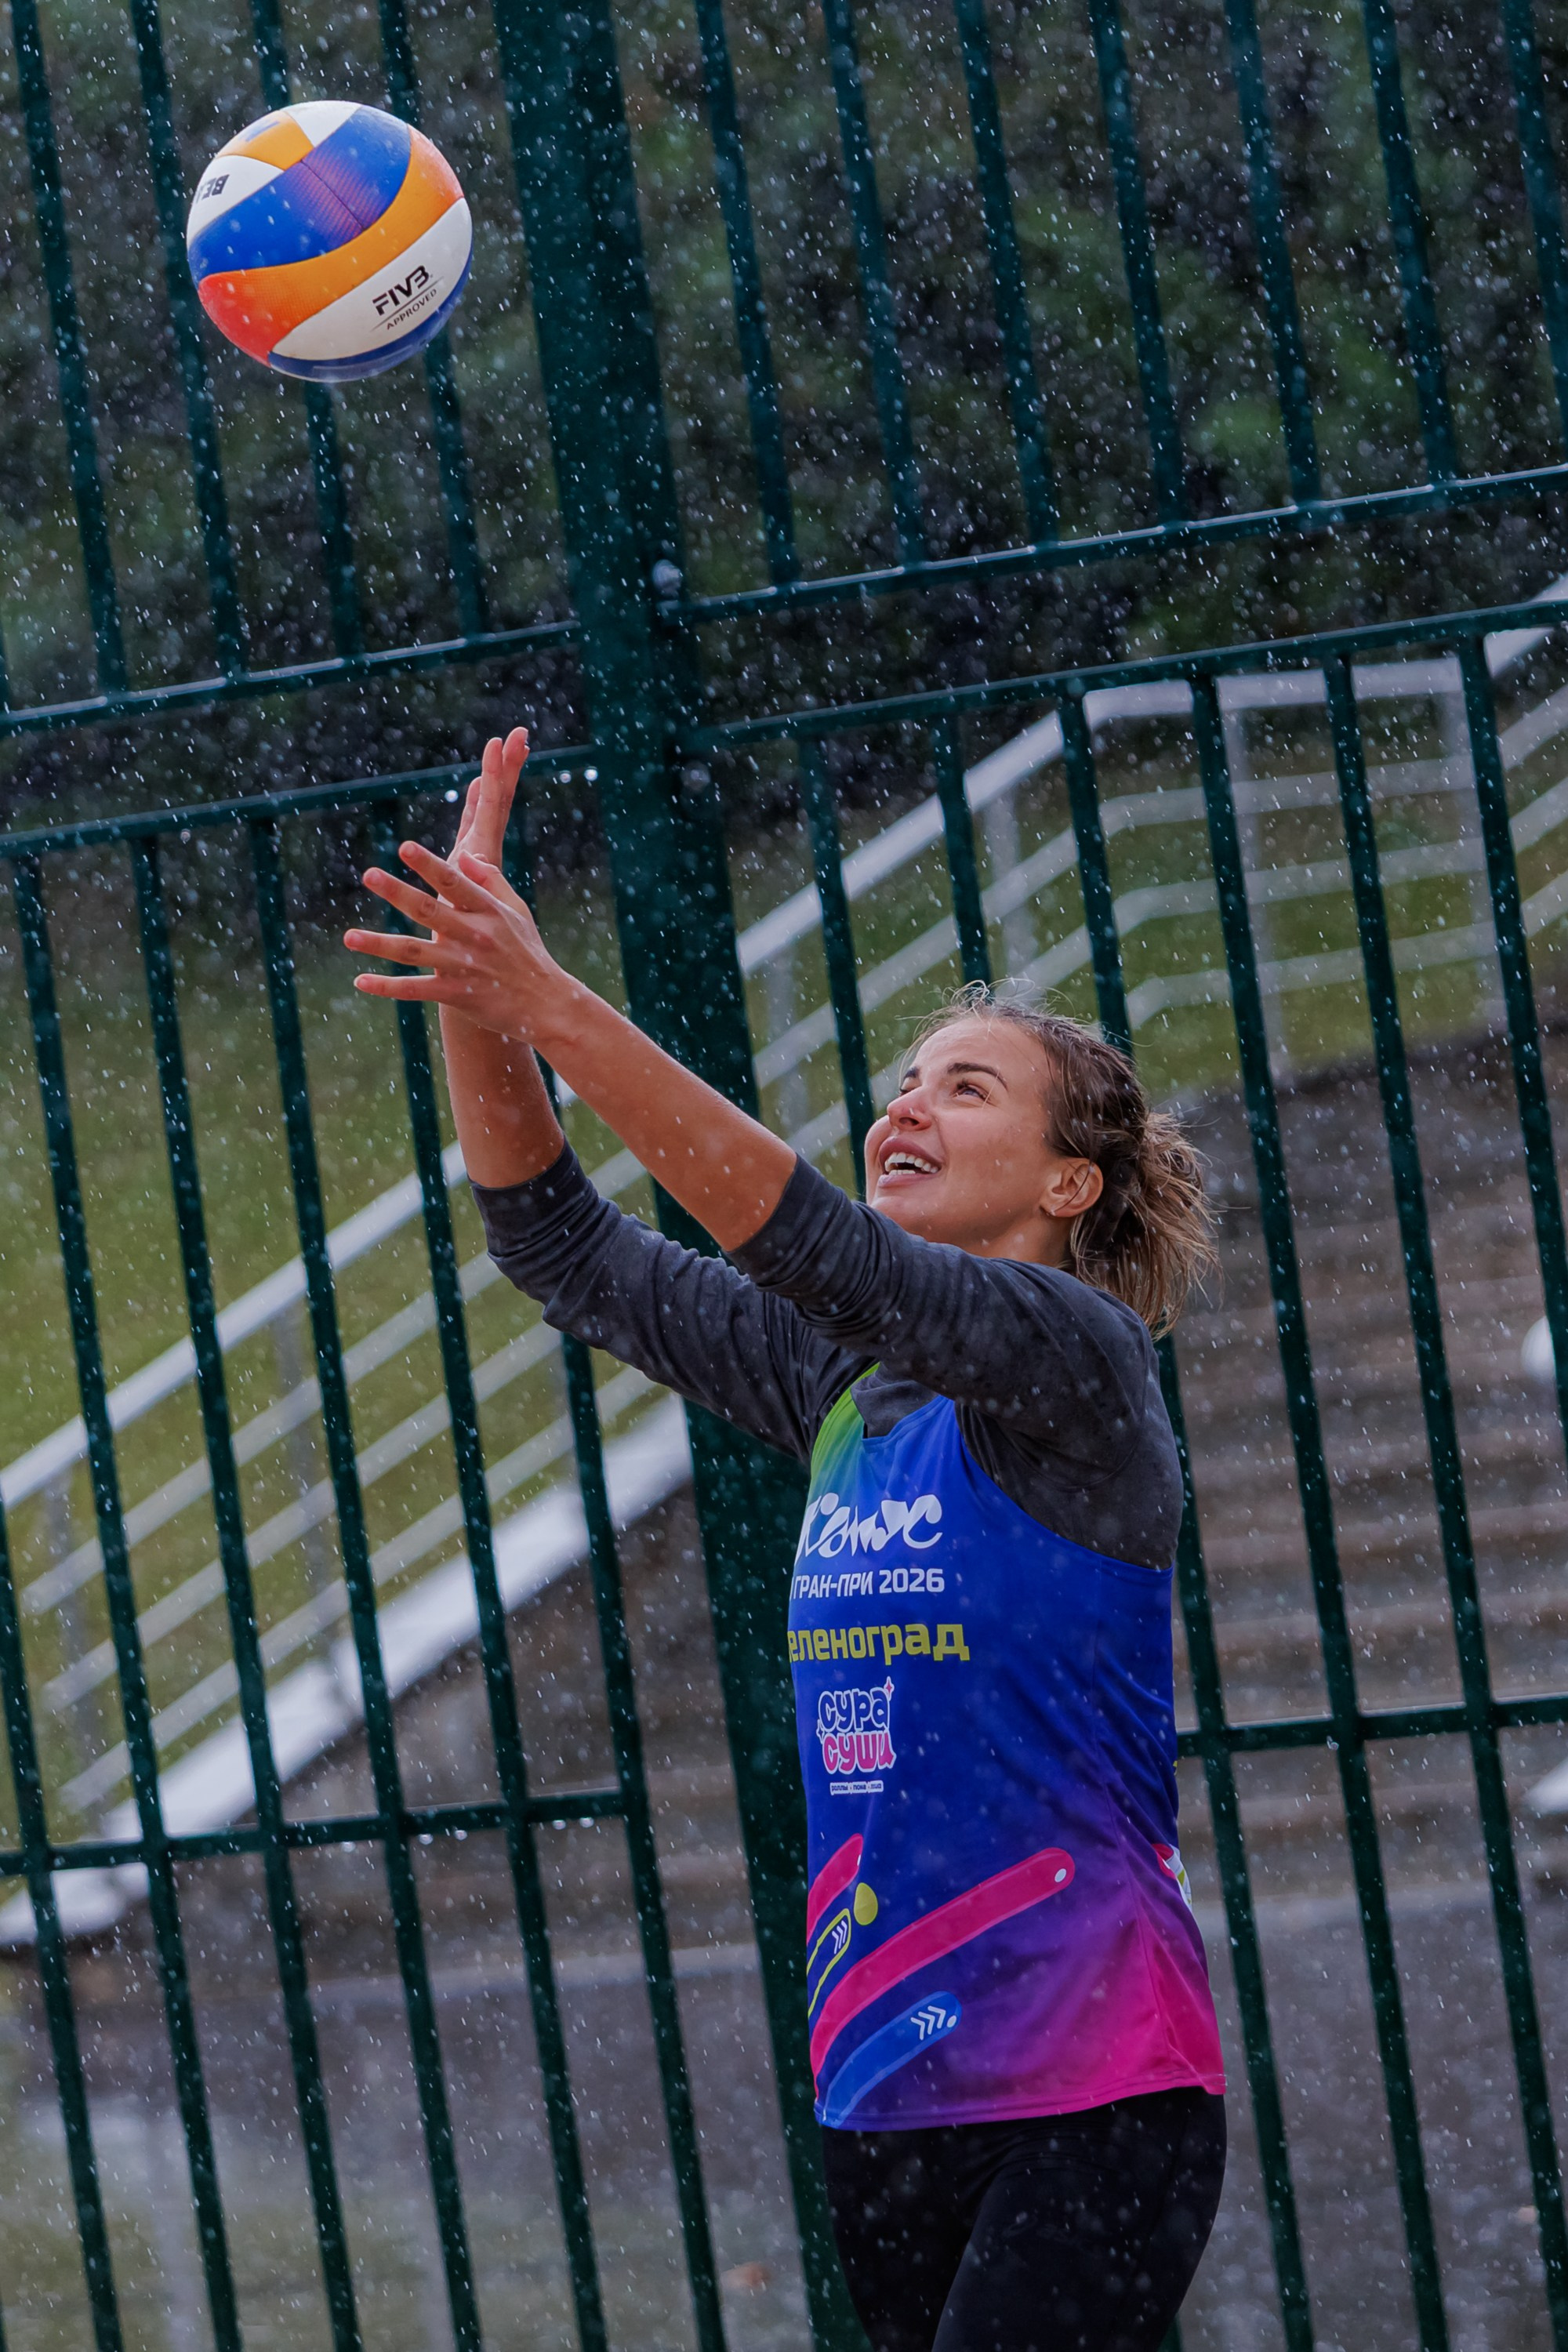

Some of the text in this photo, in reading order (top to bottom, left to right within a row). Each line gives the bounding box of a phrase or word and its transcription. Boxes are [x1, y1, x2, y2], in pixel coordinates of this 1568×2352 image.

[372, 265, 430, 316] FIVB
[387, 289, 437, 330] APPROVED
[793, 1570, 873, 1599] ГРАН-ПРИ
[879, 1568, 945, 1594] 2026
[787, 1623, 971, 1665] еленоград
